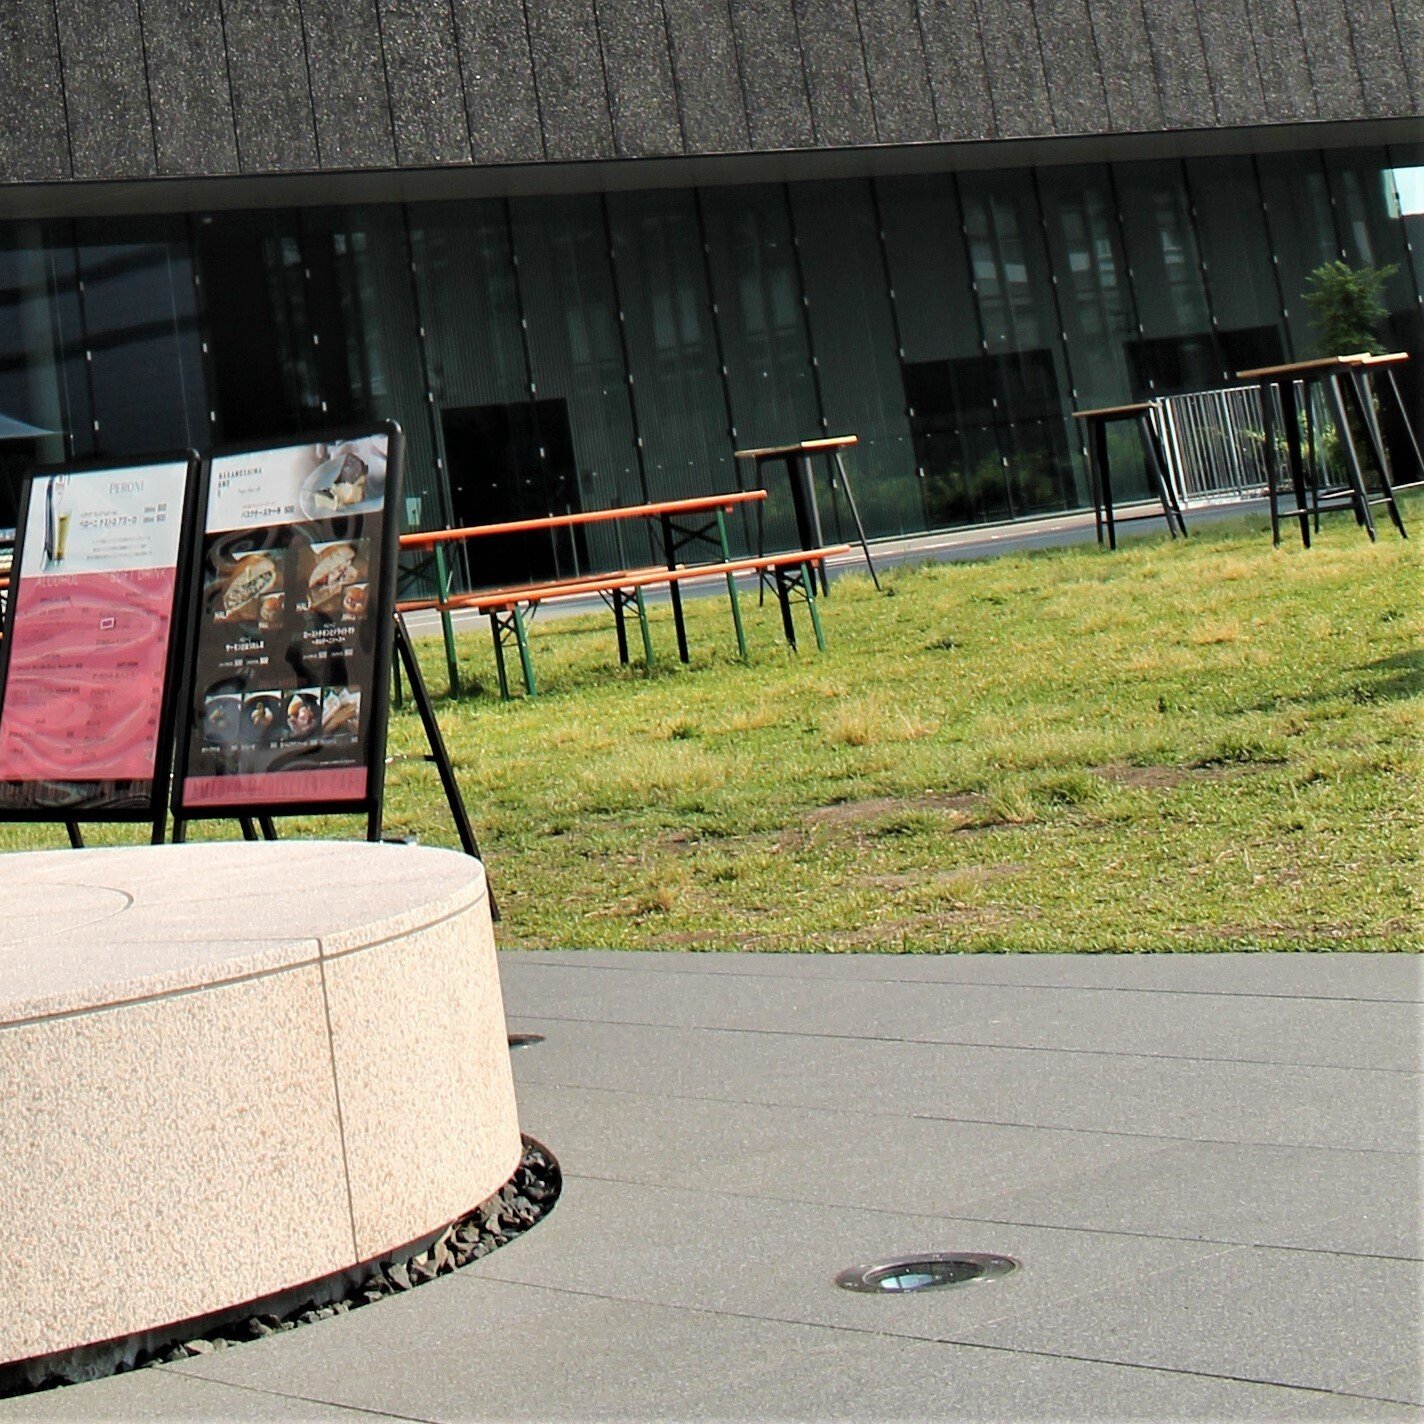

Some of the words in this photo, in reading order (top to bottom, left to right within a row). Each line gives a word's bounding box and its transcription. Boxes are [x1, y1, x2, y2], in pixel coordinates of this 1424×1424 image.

[109, 480, 144, 494] PERONI
[36, 574, 78, 587] ALCOHOL
[110, 571, 133, 583] SOFT
[137, 568, 166, 581] DRINK
